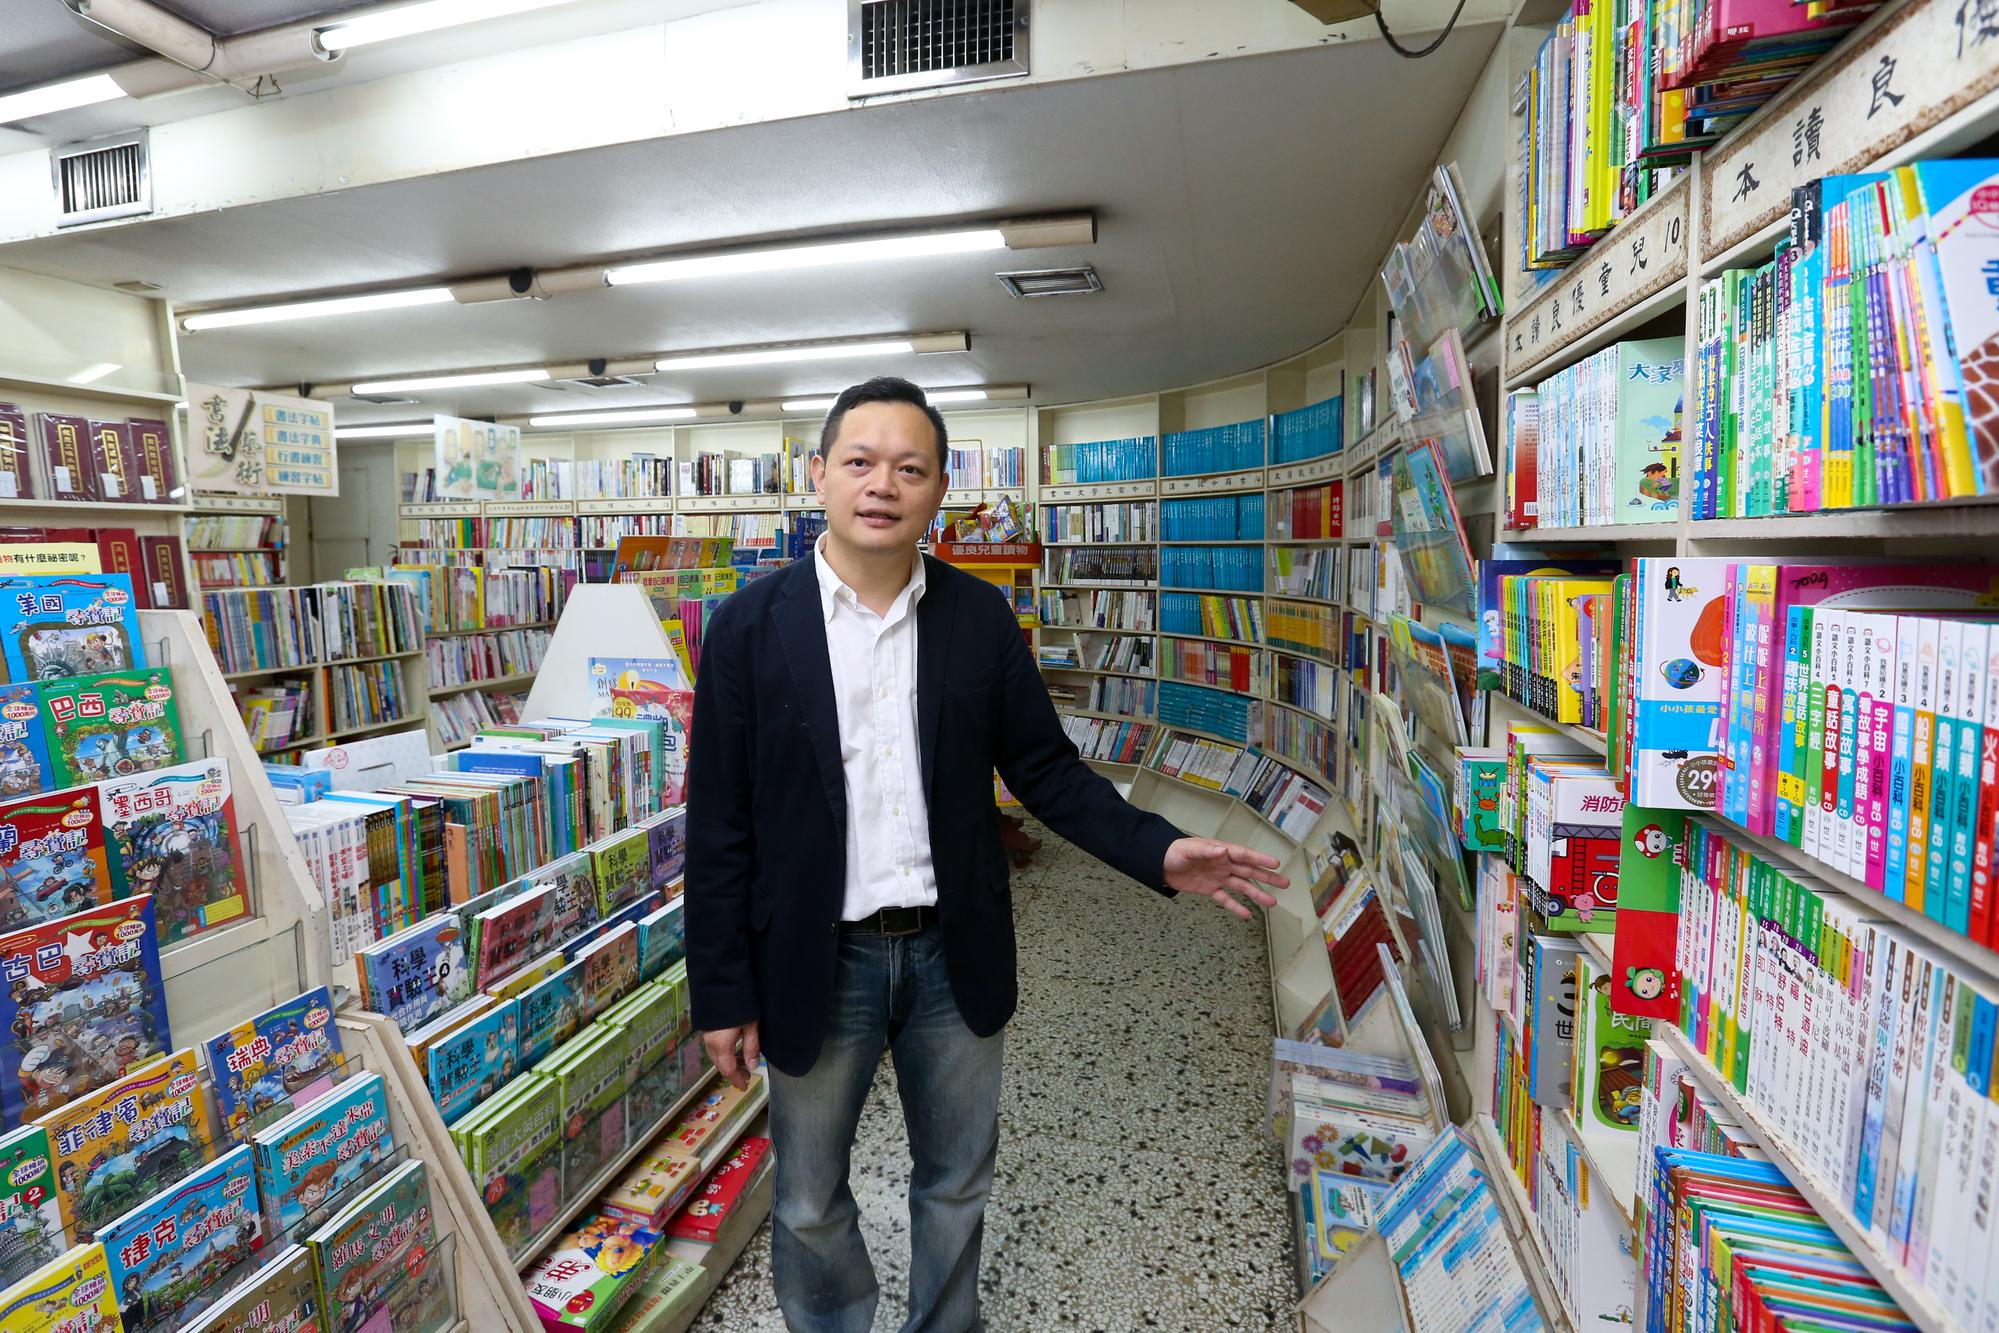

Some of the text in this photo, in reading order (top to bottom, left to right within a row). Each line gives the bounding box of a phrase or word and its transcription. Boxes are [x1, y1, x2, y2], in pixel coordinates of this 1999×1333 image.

[16, 593, 63, 616] 美國
[66, 605, 125, 626] 尋寶記
[1783, 660, 1799, 724] 趣味故事
[1847, 677, 1852, 685] 6
[1879, 689, 1885, 698] 2
[1901, 694, 1907, 704] 3
[49, 694, 105, 723] 巴西
[108, 702, 167, 726] 尋寶記
[1795, 663, 1810, 748] 世界童話故事
[1809, 687, 1824, 751] 三字經
[1921, 698, 1927, 707] 4
[1943, 704, 1950, 713] 6
[1966, 707, 1973, 717] 6
[1824, 690, 1840, 771] 童話故事
[1839, 693, 1855, 776] 寓言故事
[1855, 696, 1872, 801] 看故事學成語
[1871, 707, 1889, 798] 宇宙小百科
[112, 787, 173, 818] 墨西哥
[165, 797, 221, 823] 尋寶記
[19, 827, 88, 861] 尋寶記
[607, 847, 629, 871] 科學
[1762, 920, 1769, 930] 15
[2, 942, 63, 982] 古巴
[71, 938, 143, 976] 尋寶記
[391, 945, 427, 981] 科學
[386, 966, 440, 1011] 實驗王
[1766, 959, 1777, 1011] 瓦特
[1774, 972, 1787, 1033] 舒伯特
[1786, 981, 1799, 1048] 福特
[1799, 993, 1813, 1057] 甘迺迪
[1812, 981, 1824, 1043] 迪士尼
[1833, 999, 1846, 1063] 卡內基
[226, 1036, 272, 1074] 瑞典
[274, 1026, 327, 1067] 尋寶記
[446, 1036, 475, 1071] 科學
[439, 1052, 482, 1090] 實驗王
[56, 1095, 139, 1157] 菲律賓
[128, 1096, 193, 1142] 尋寶記
[282, 1100, 374, 1176] 美索不達米亞
[337, 1118, 385, 1161] 尋寶記
[27, 1189, 40, 1201] 2
[419, 1207, 427, 1220] 2
[120, 1214, 177, 1271] 捷克
[183, 1196, 243, 1249] 尋寶記
[331, 1202, 396, 1273] 羅馬文明
[371, 1214, 417, 1263] 尋寶記
